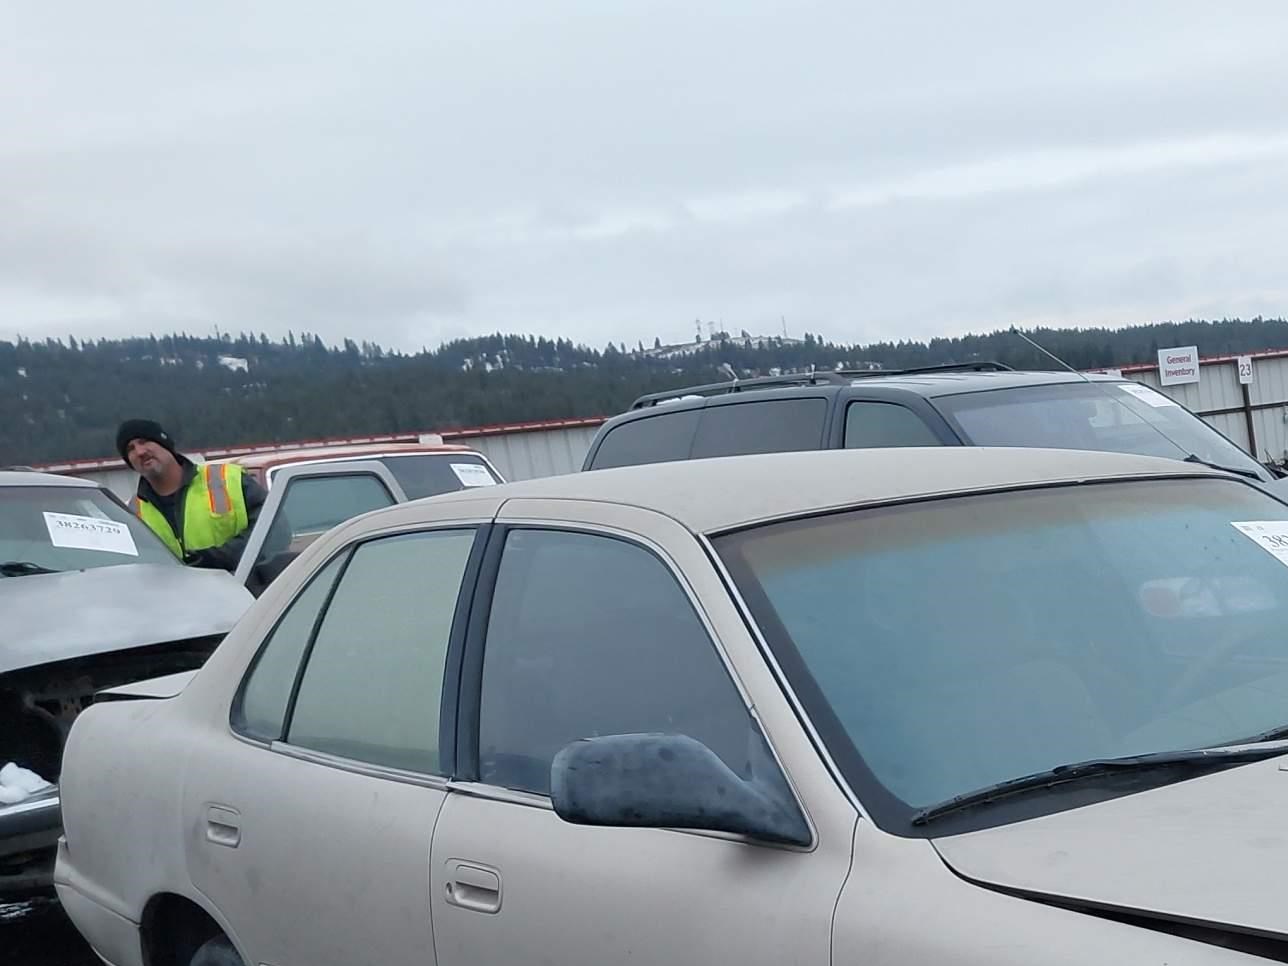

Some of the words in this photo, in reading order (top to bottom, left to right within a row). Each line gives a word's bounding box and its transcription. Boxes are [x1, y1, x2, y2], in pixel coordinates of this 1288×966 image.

[1167, 354, 1191, 364] General
[1165, 367, 1195, 377] Inventory
[1240, 364, 1251, 377] 23
